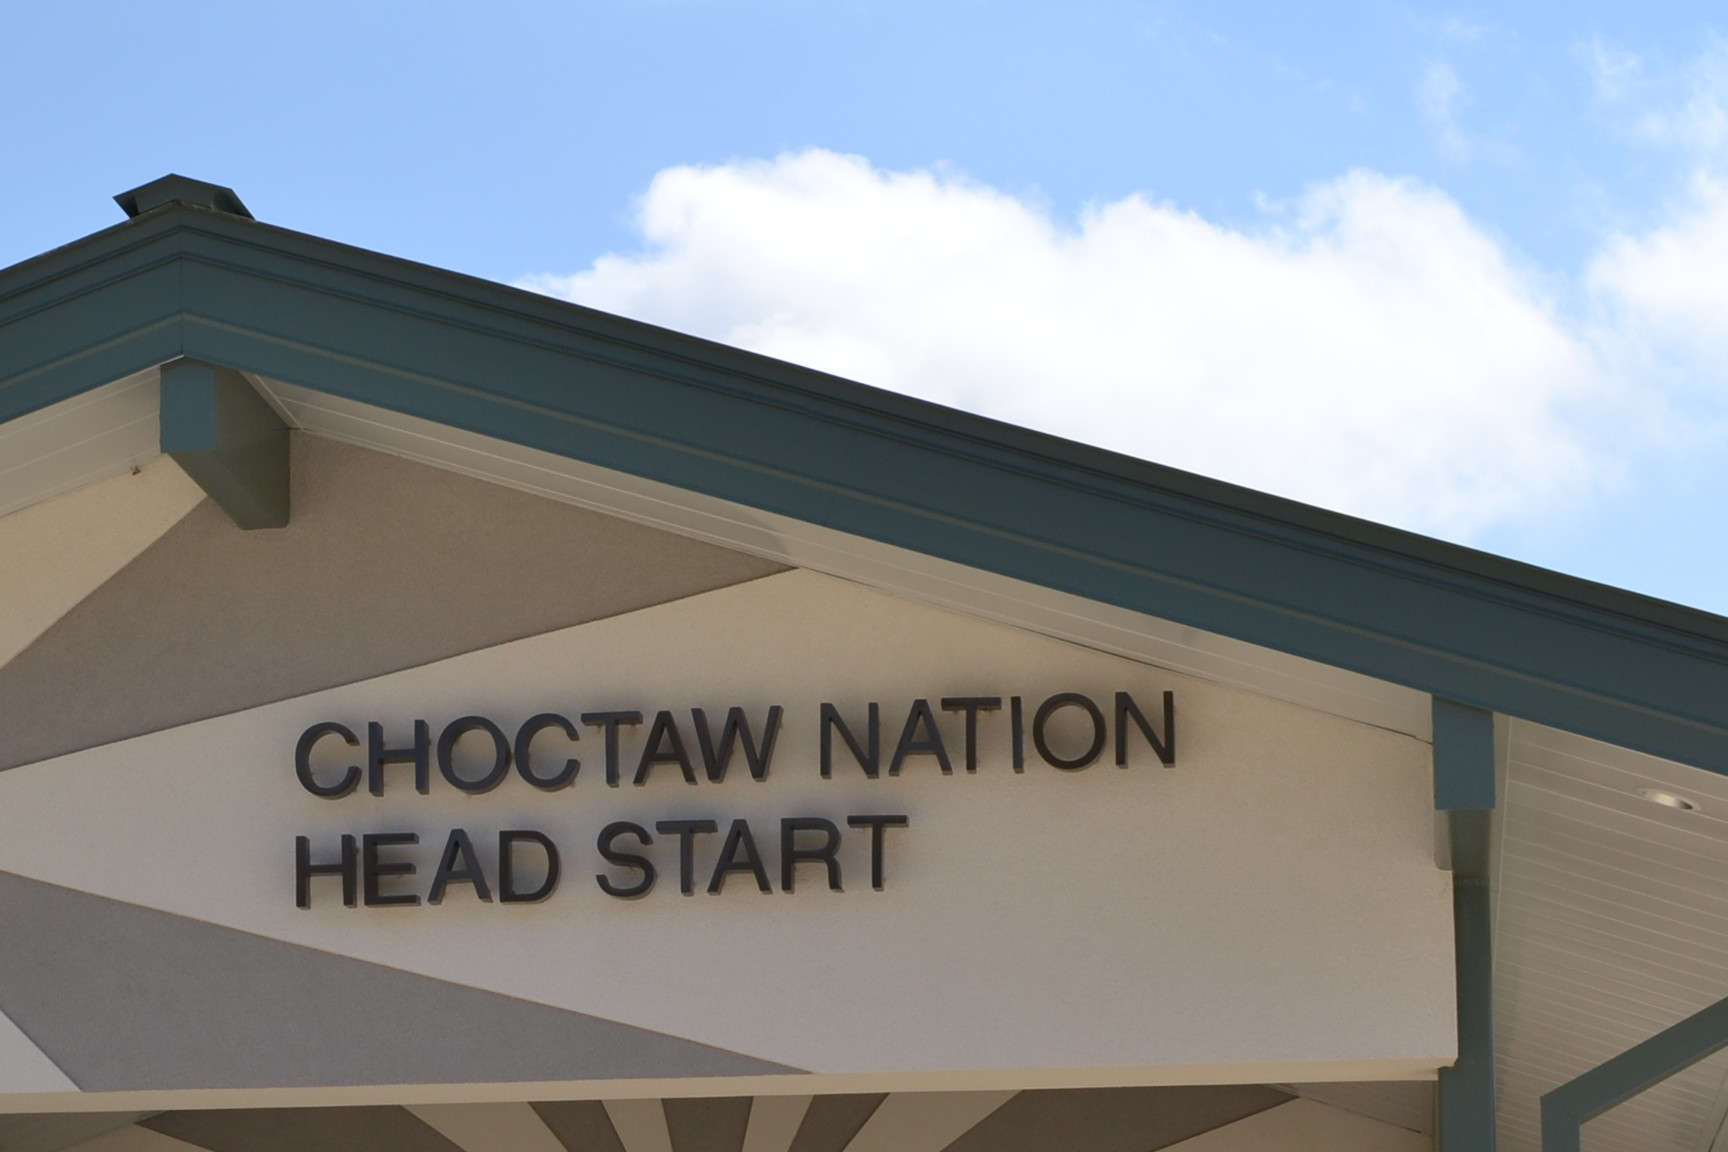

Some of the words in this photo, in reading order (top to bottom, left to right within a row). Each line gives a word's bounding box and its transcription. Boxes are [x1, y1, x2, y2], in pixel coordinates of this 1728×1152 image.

[294, 704, 784, 800] CHOCTAW
[820, 689, 1176, 780] NATION
[294, 828, 561, 909] HEAD
[595, 813, 910, 899] START
